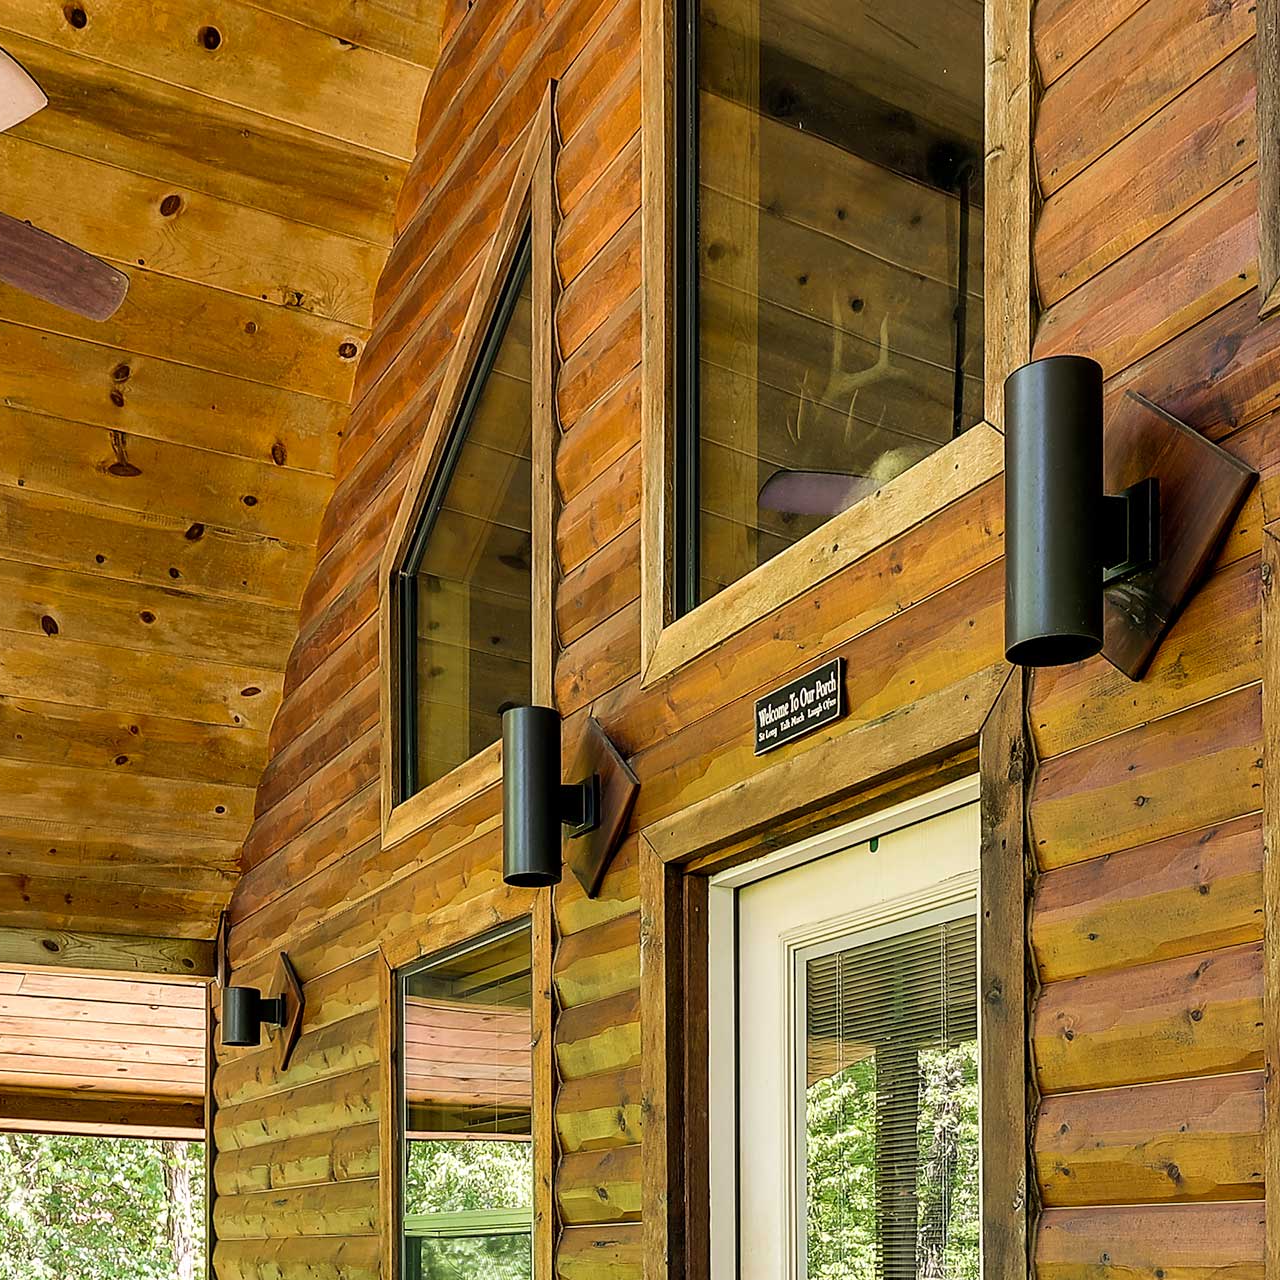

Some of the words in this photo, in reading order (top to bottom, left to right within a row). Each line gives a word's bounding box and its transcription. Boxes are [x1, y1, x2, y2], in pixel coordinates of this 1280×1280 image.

[758, 701, 789, 728] Welcome
[789, 692, 799, 713] To
[800, 687, 815, 707] Our
[816, 671, 836, 699] Porch
[766, 727, 778, 739] Long
[780, 720, 790, 731] Talk
[791, 711, 804, 727] Much
[807, 703, 823, 718] Laugh
[823, 698, 836, 710] Often
